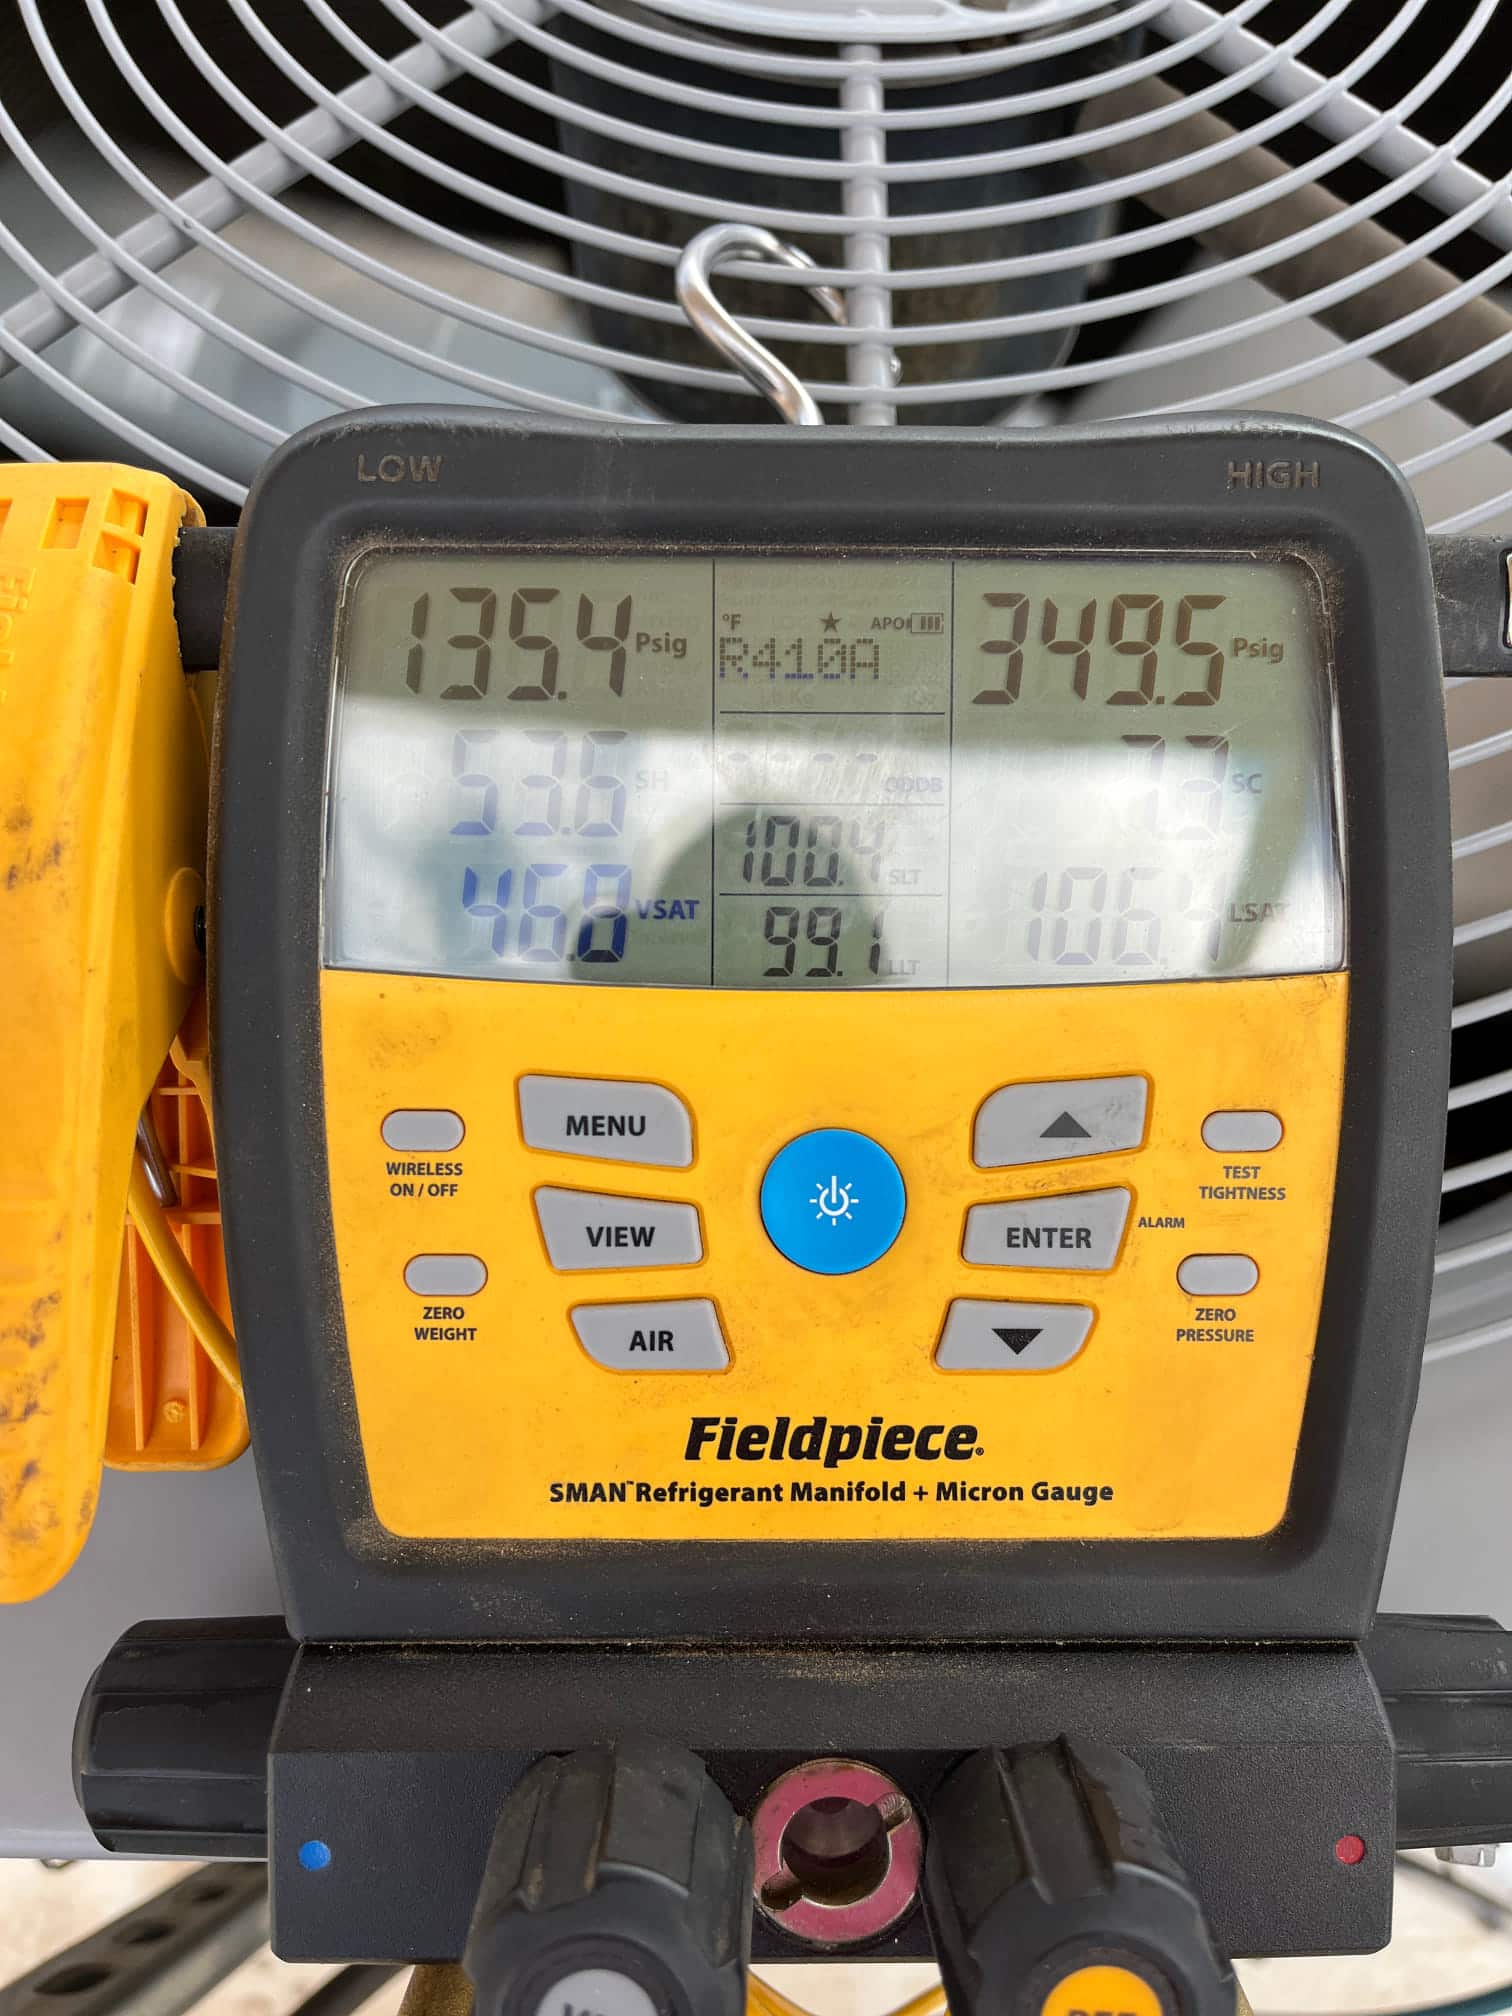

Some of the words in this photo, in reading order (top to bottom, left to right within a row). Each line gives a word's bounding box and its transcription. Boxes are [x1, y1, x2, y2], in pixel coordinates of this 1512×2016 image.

[355, 454, 444, 483] LOW
[1226, 460, 1321, 490] HIGH
[404, 587, 633, 701] 135.4
[635, 632, 688, 659] Psig
[971, 592, 1227, 707] 349.5
[1231, 636, 1284, 664] Psig
[719, 637, 880, 681] R410A
[634, 770, 669, 789] SH
[1231, 772, 1263, 795] SC
[888, 869, 921, 886] SLT
[635, 899, 700, 921] VSAT
[565, 1115, 646, 1137] MENU
[386, 1162, 463, 1177] WIRELESS
[1222, 1165, 1261, 1180] TEST
[389, 1183, 416, 1198] ON
[428, 1183, 459, 1198] OFF
[1199, 1185, 1287, 1201] TIGHTNESS
[1138, 1216, 1185, 1229] ALARM
[586, 1226, 656, 1248] VIEW
[1006, 1227, 1092, 1249] ENTER
[422, 1306, 465, 1321] ZERO
[1195, 1307, 1237, 1322] ZERO
[414, 1327, 477, 1342] WEIGHT
[629, 1330, 675, 1352] AIR
[1176, 1327, 1255, 1343] PRESSURE
[635, 1482, 784, 1507] Refrigerant
[790, 1481, 906, 1503] Manifold
[935, 1482, 1024, 1503] Micron
[1031, 1482, 1114, 1507] Gauge
